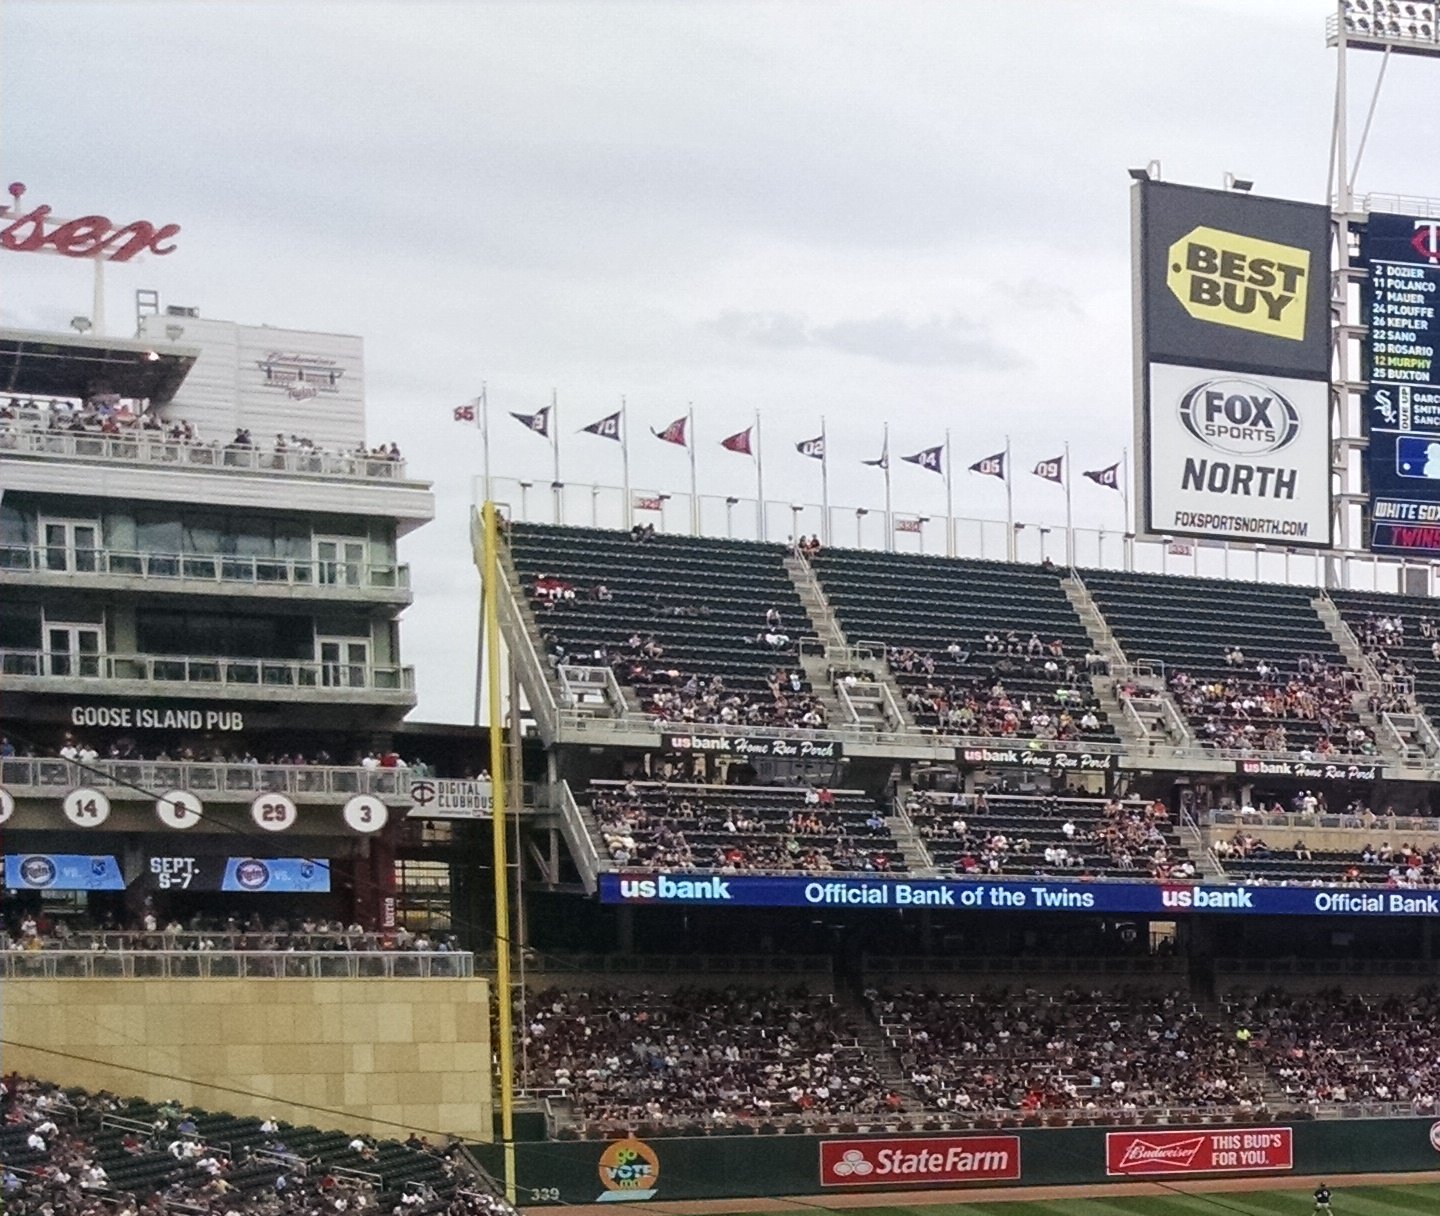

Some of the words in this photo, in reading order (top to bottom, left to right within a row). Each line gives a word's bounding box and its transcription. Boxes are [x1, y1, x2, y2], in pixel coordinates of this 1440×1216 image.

[1186, 242, 1305, 294] BEST
[1375, 265, 1383, 275] 2
[1387, 266, 1425, 279] DOZIER
[1373, 278, 1385, 288] 11
[1387, 279, 1436, 292] POLANCO
[1189, 274, 1296, 322] BUY
[1375, 291, 1383, 300] 7
[1387, 292, 1425, 304] MAUER
[1373, 304, 1386, 314] 24
[1387, 304, 1435, 318] PLOUFFE
[1373, 317, 1386, 326] 26
[1387, 318, 1429, 330] KEPLER
[1373, 330, 1386, 340] 22
[1388, 331, 1416, 342] SANO
[1373, 343, 1386, 353] 20
[1387, 344, 1434, 357] ROSARIO
[1374, 356, 1386, 366] 12
[1387, 357, 1432, 369] MURPHY
[1373, 368, 1386, 378] 25
[1388, 369, 1430, 382] BUXTON
[1205, 391, 1274, 428] FOX
[1204, 424, 1276, 442] SPORTS
[1181, 458, 1298, 499] NORTH
[1375, 502, 1417, 519] WHITE
[1174, 511, 1308, 536] FOXSPORTSNORTH.COM
[71, 706, 132, 728] GOOSE
[136, 708, 203, 730] ISLAND
[207, 711, 244, 731] PUB
[734, 738, 768, 754] Home
[772, 740, 797, 755] Run
[800, 741, 834, 756] Porch
[438, 782, 480, 795] DIGITAL
[75, 799, 98, 818] 14
[438, 796, 494, 809] CLUBHOUS
[262, 804, 286, 821] 29
[360, 805, 372, 823] 3
[151, 857, 200, 874] SEPT.
[805, 883, 888, 905] Official
[896, 884, 955, 906] Bank
[961, 886, 985, 906] of
[990, 887, 1026, 906] the
[1031, 887, 1095, 908] Twins
[1315, 893, 1384, 912] Official
[1390, 895, 1439, 913] Bank
[1211, 1135, 1241, 1150] THIS
[1243, 1133, 1281, 1149] BUD'S
[1129, 1145, 1196, 1160] Budweiser
[1211, 1152, 1237, 1166] FOR
[1240, 1150, 1270, 1164] YOU.
[606, 1164, 652, 1179] VOTE
[530, 1188, 560, 1200] 339
